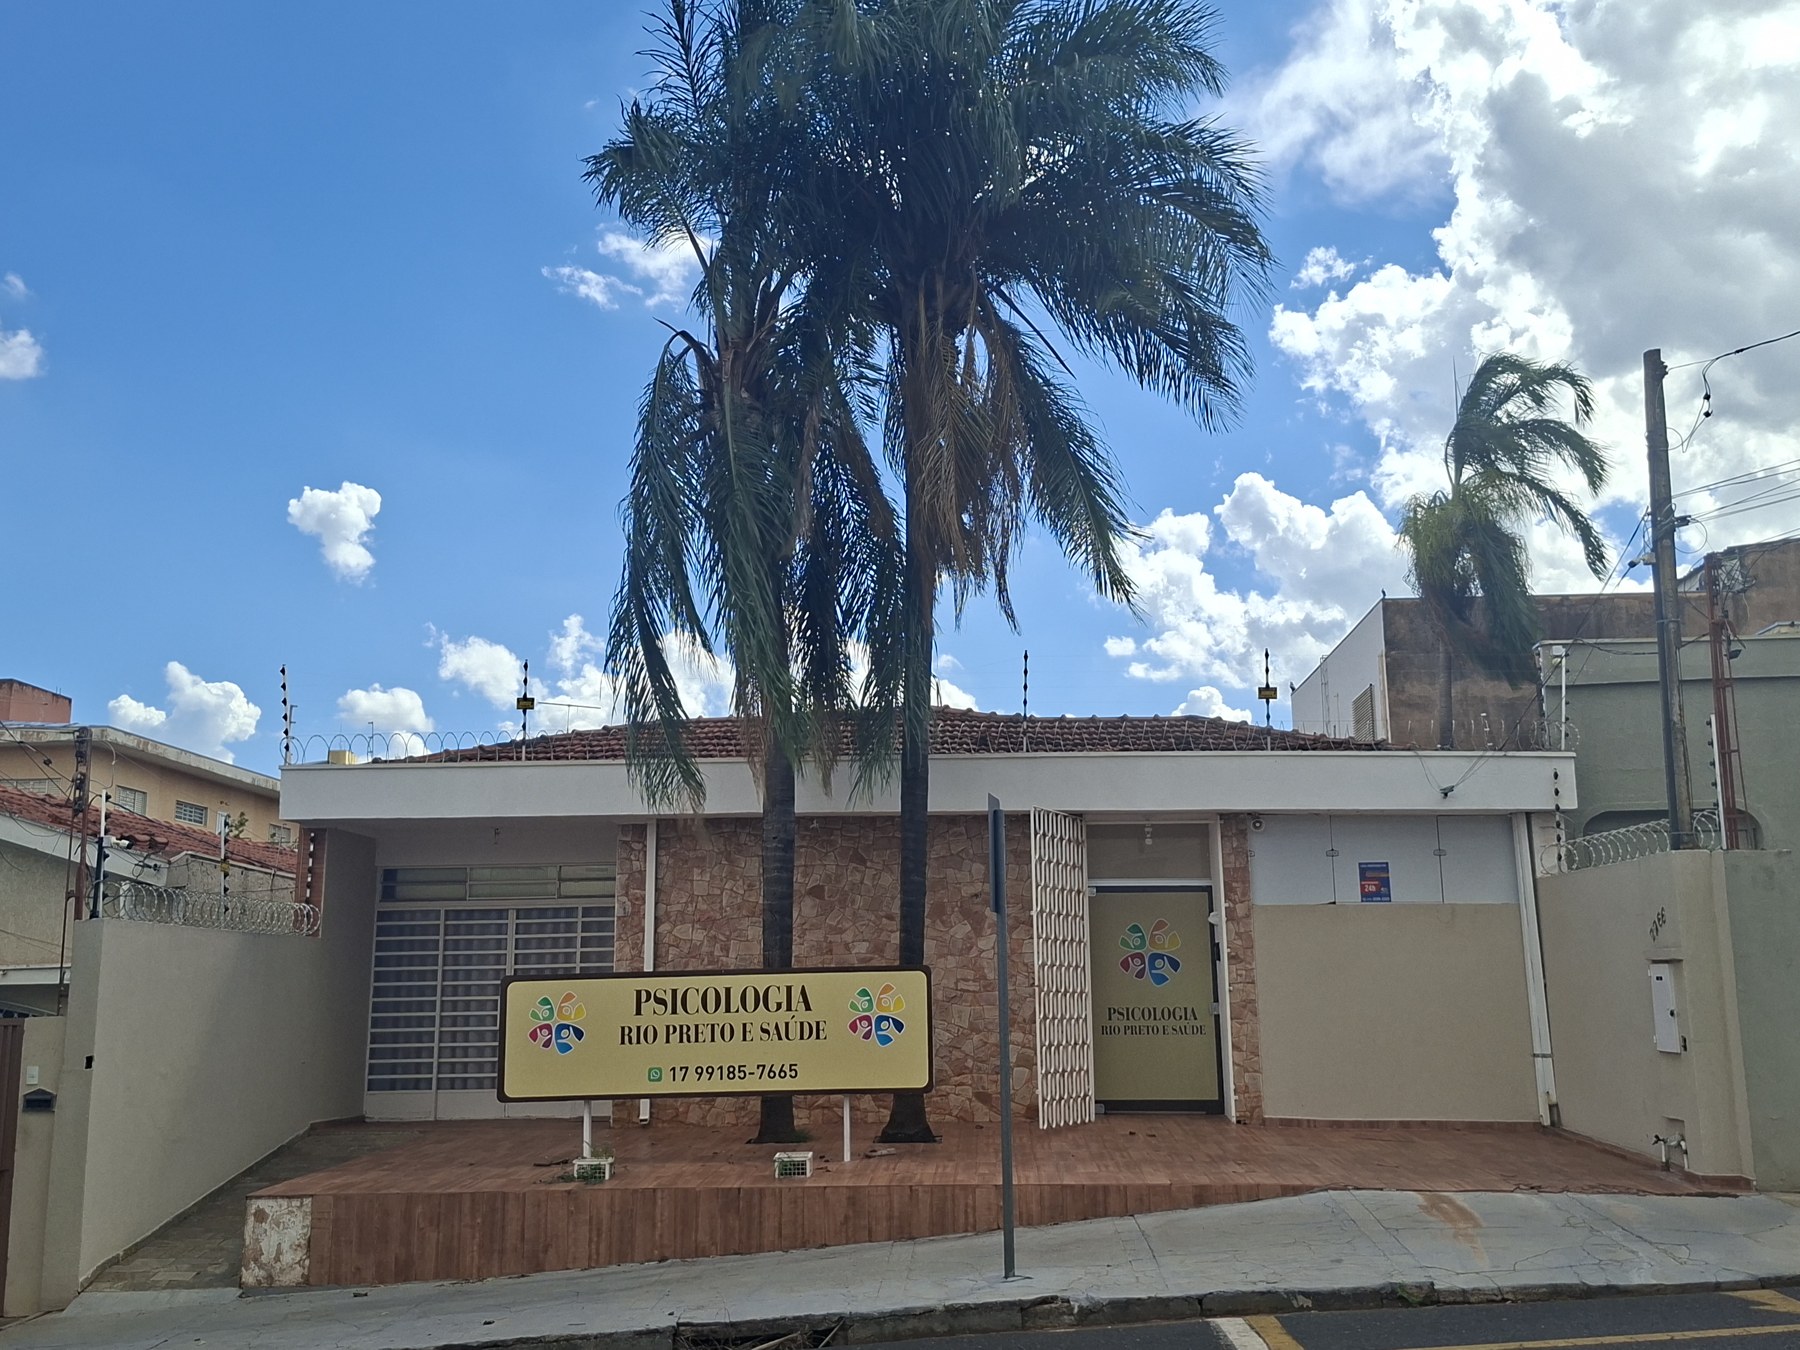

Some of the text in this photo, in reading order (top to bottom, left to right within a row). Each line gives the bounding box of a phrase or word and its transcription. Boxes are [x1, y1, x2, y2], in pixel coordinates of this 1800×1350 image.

[633, 984, 813, 1017] PSICOLOGIA
[1107, 1006, 1198, 1021] PSICOLOGIA
[619, 1014, 828, 1046] RIO PRETO E SAÚDE
[1101, 1022, 1207, 1035] RIO PRETO E SAÚDE
[669, 1063, 799, 1082] 17 99185-7665
